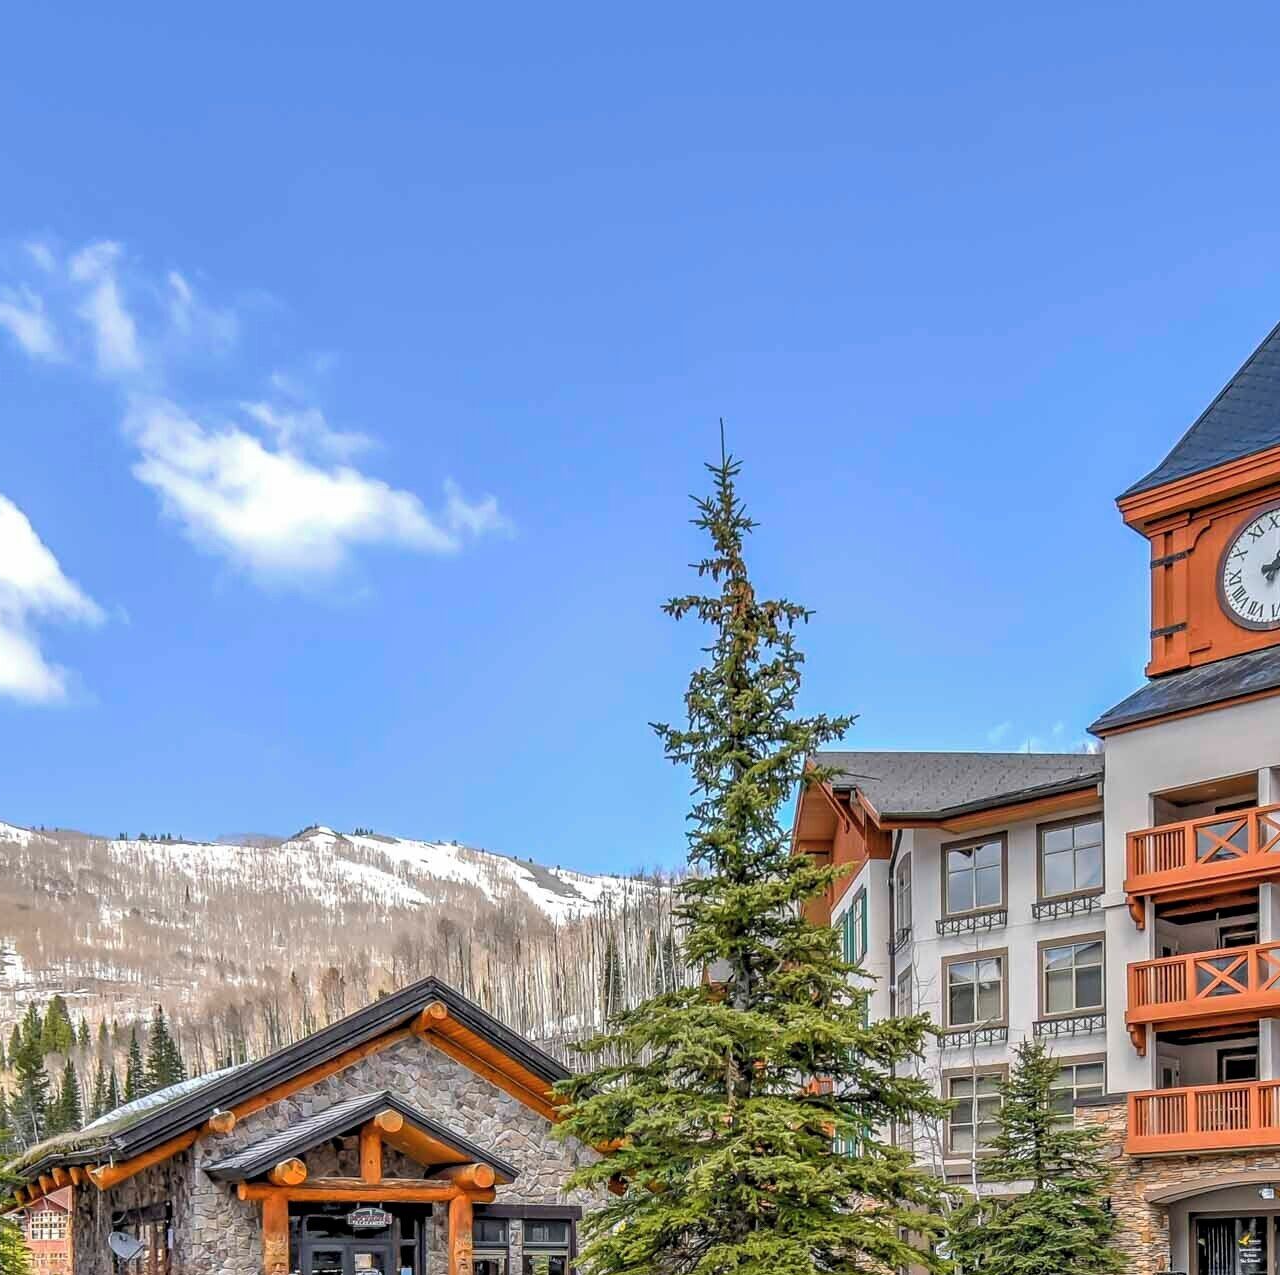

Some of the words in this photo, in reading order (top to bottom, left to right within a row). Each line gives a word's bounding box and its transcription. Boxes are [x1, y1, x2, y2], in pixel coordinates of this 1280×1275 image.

[1248, 525, 1264, 543] XI
[1233, 547, 1248, 560] X
[1228, 569, 1242, 586] IX
